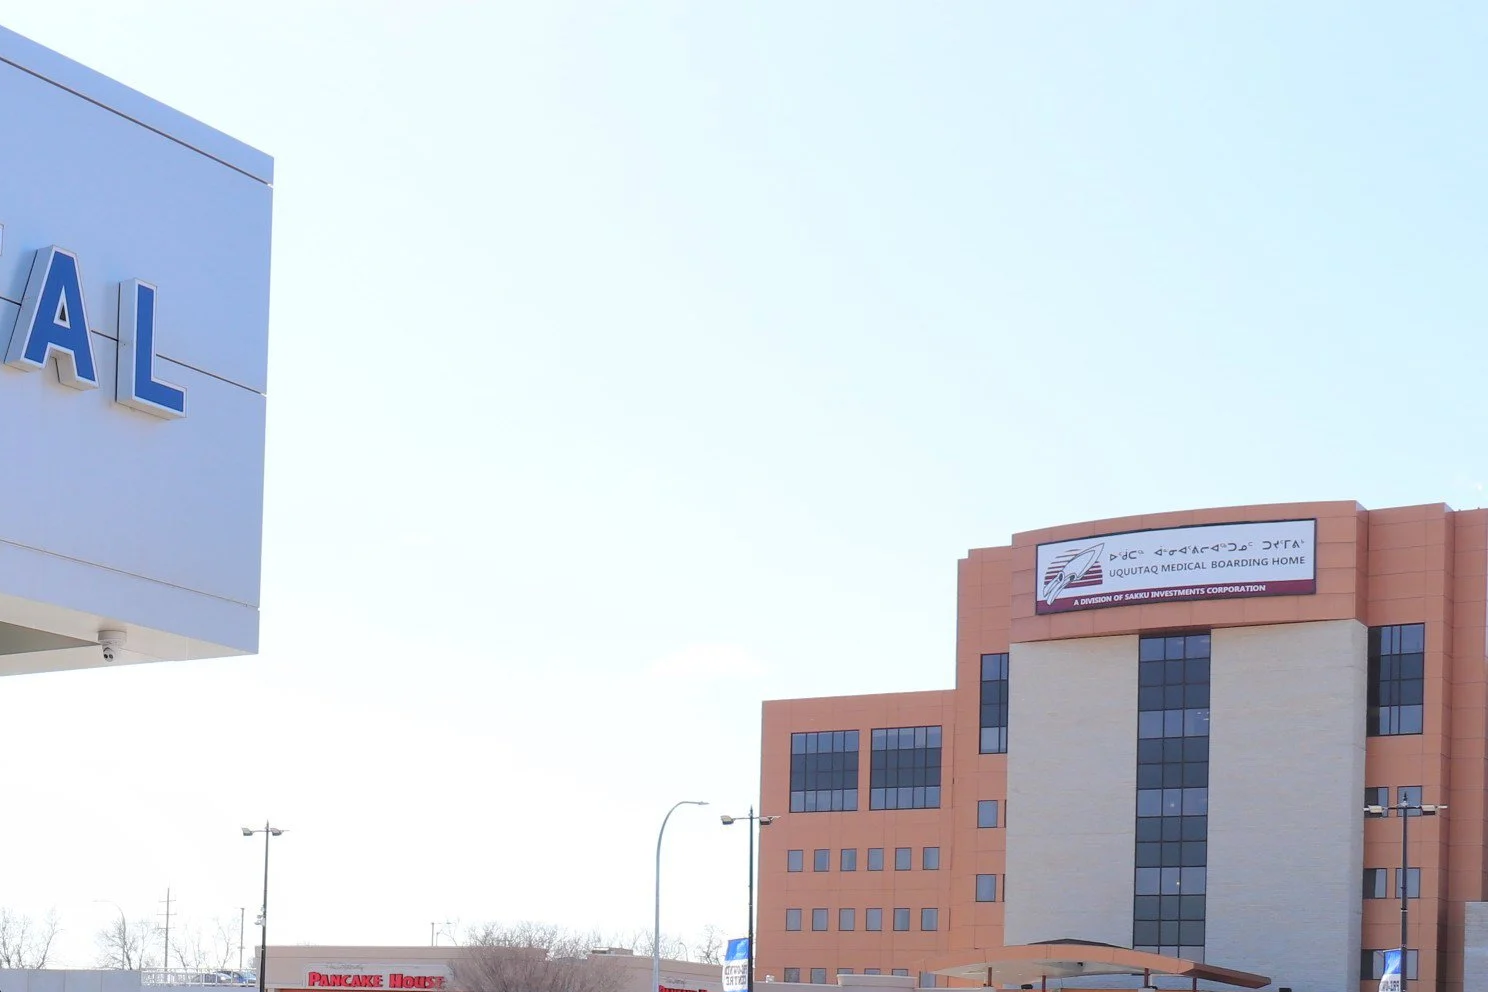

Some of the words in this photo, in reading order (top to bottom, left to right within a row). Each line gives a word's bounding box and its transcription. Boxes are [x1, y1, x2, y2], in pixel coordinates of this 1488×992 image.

[1109, 566, 1159, 578] UQUUTAQ
[1161, 561, 1207, 573] MEDICAL
[1211, 557, 1269, 569] BOARDING
[1272, 555, 1306, 565] HOME
[1073, 598, 1080, 606] A
[1080, 595, 1112, 605] DIVISION
[1113, 594, 1123, 602] OF
[1124, 591, 1150, 601] SAKKU
[1151, 587, 1205, 598] INVESTMENTS
[1206, 584, 1266, 594] CORPORATION
[308, 971, 384, 988] PANCAKE
